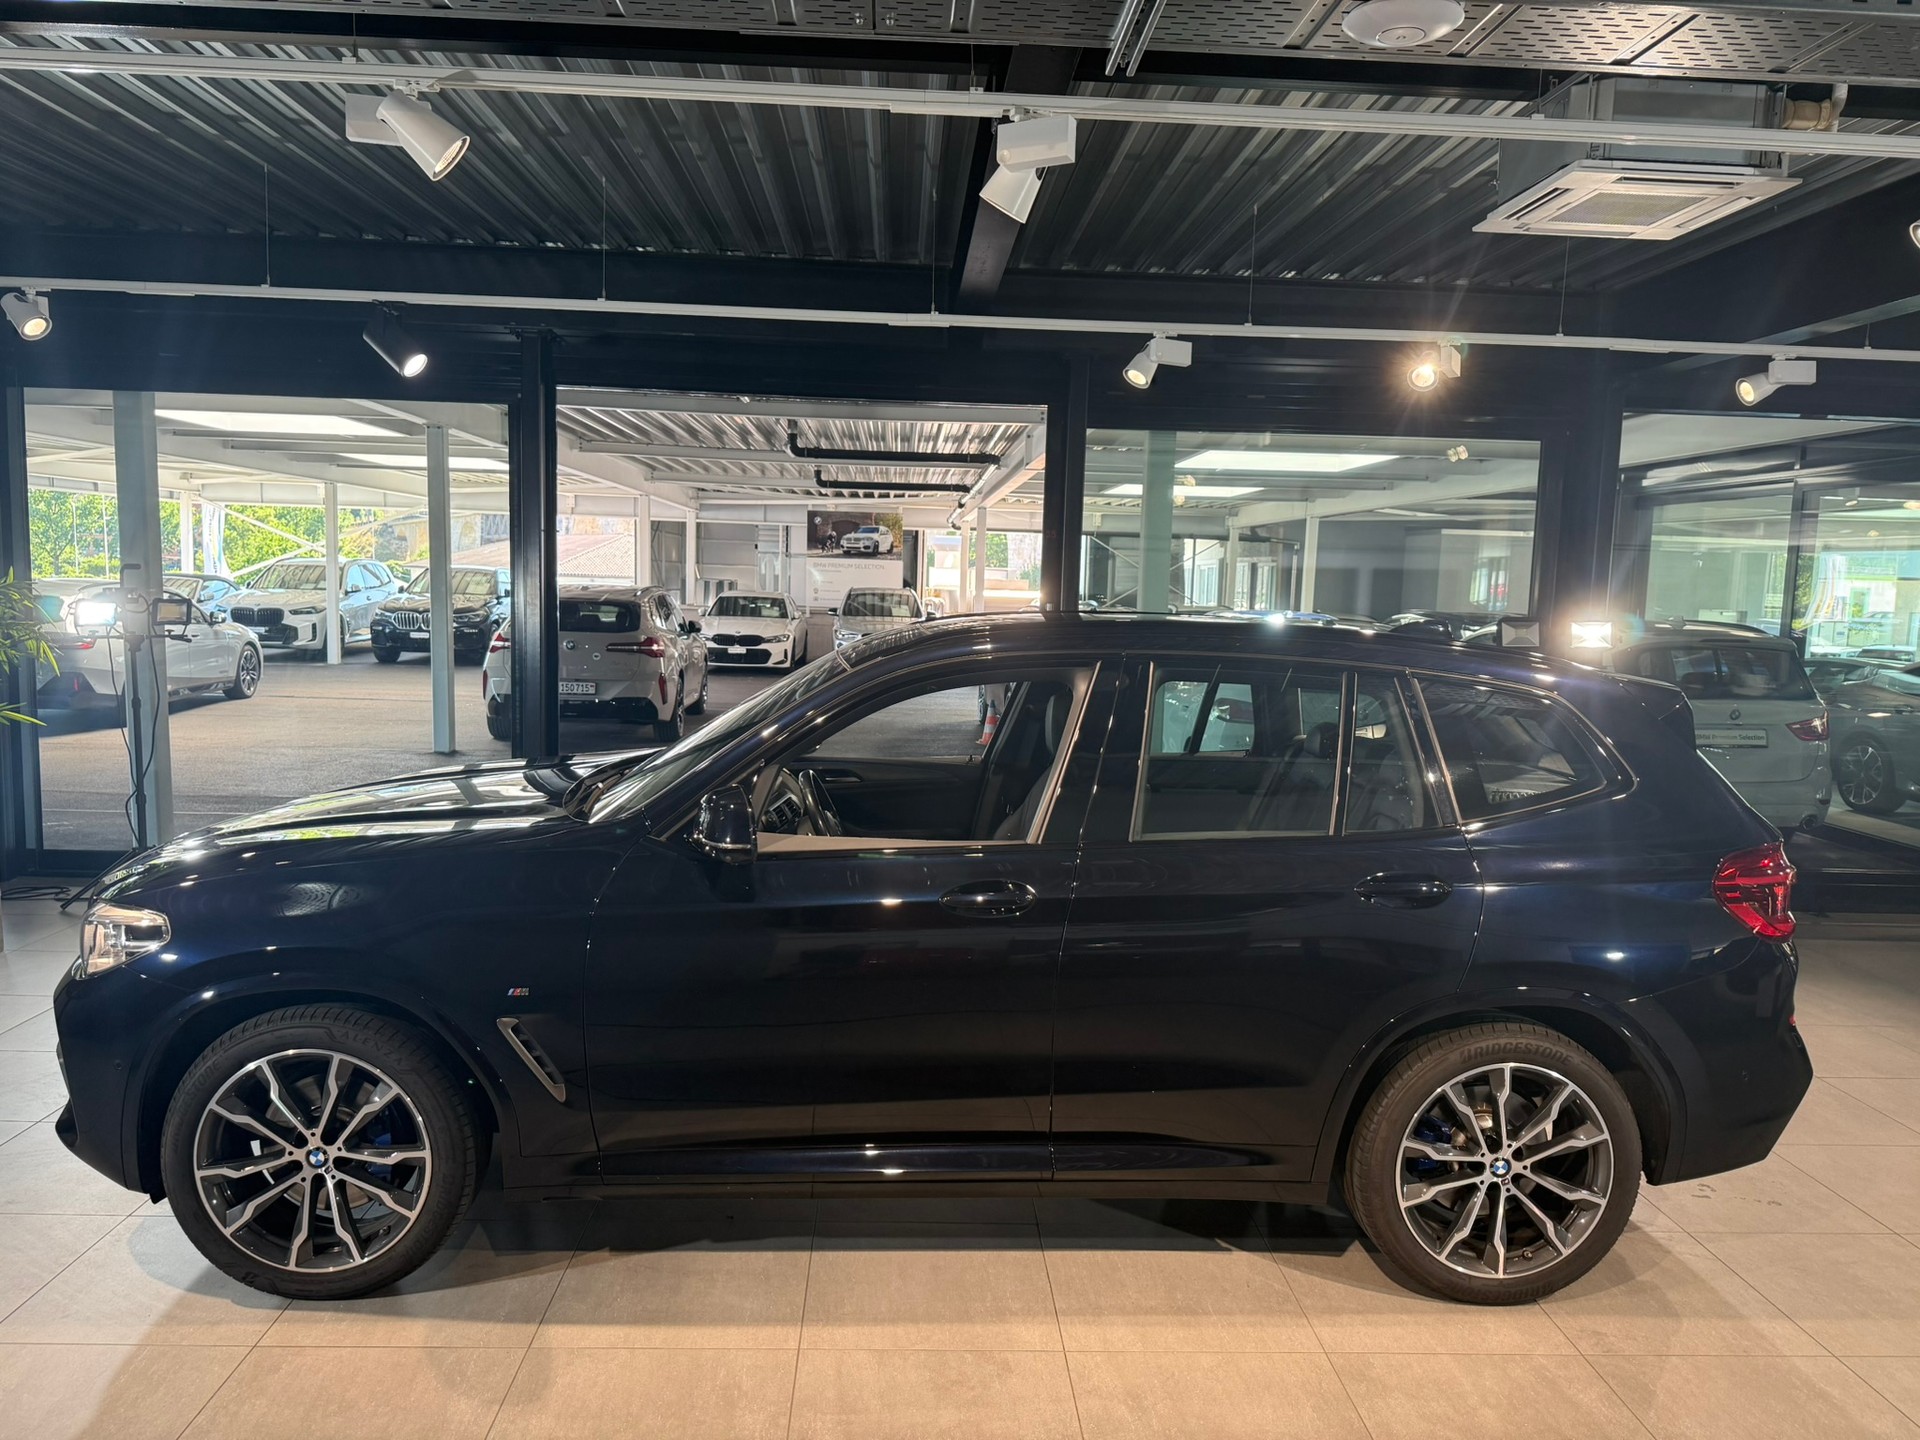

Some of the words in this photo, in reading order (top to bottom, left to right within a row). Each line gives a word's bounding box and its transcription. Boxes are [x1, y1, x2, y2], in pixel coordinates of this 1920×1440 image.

[561, 683, 590, 692] 150715
[340, 1030, 403, 1066] ALENZA
[1460, 1042, 1573, 1065] BRIDGESTONE
